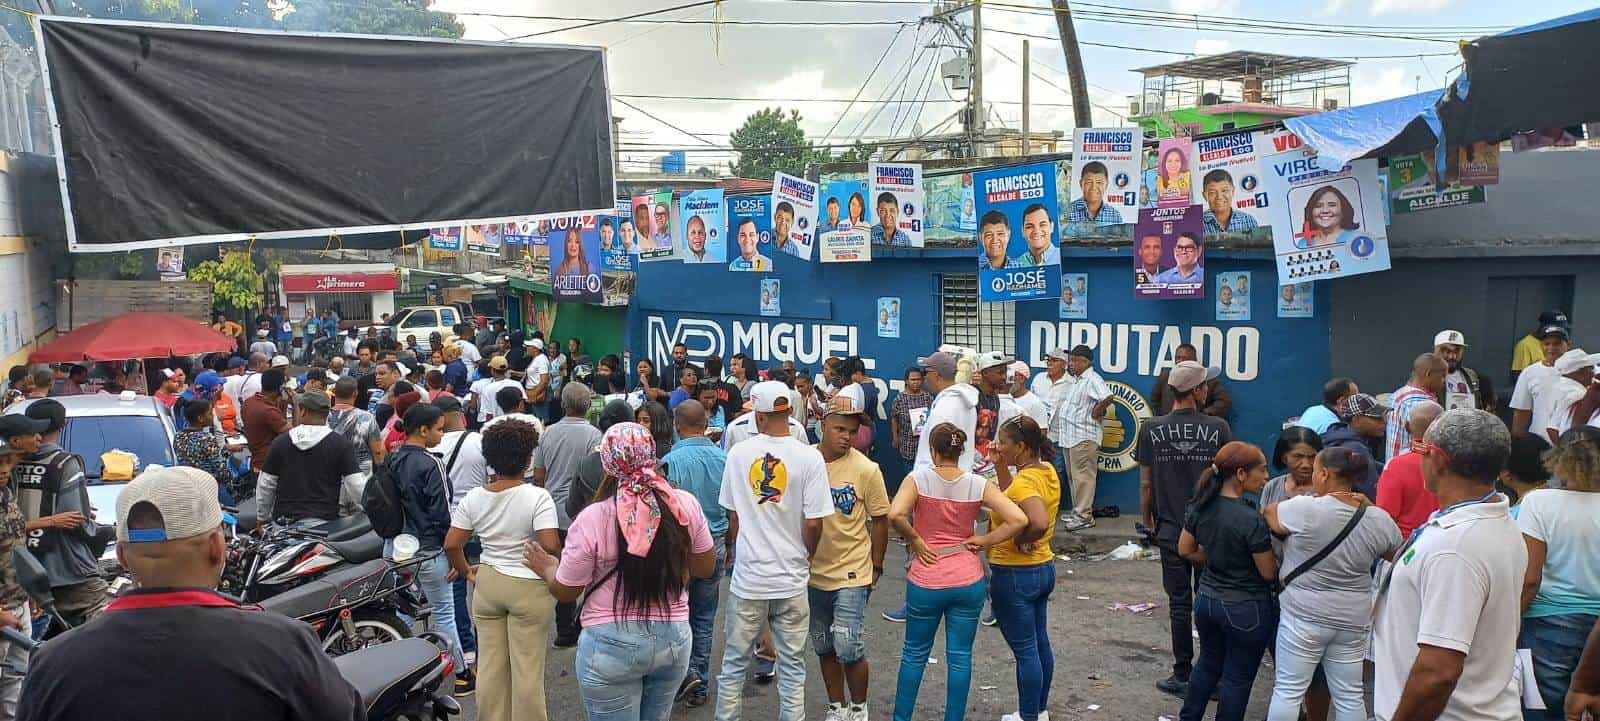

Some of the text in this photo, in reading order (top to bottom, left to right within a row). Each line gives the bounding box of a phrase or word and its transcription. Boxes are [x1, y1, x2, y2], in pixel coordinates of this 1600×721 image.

[1083, 131, 1133, 144] FRANCISCO
[1198, 132, 1253, 153] FRANCISCO
[876, 166, 914, 178] FRANCISCO
[780, 176, 815, 196] FRANCISCO
[984, 173, 1043, 194] FRANCISCO
[988, 190, 1042, 203] ALCALDE SDO
[1107, 192, 1136, 207] VOTA 1
[1236, 193, 1269, 210] VOTA 1
[1409, 191, 1470, 208] ALCALDE
[550, 215, 595, 230] VOTA 2
[553, 274, 587, 290] ARLETTE
[1005, 267, 1046, 286] JOSÉ
[732, 320, 876, 371] MIGUEL
[1029, 320, 1260, 381] DIPUTADO
[1150, 423, 1220, 447] ATHENA
[17, 465, 46, 475] OTO
[1096, 455, 1122, 470] PRM
